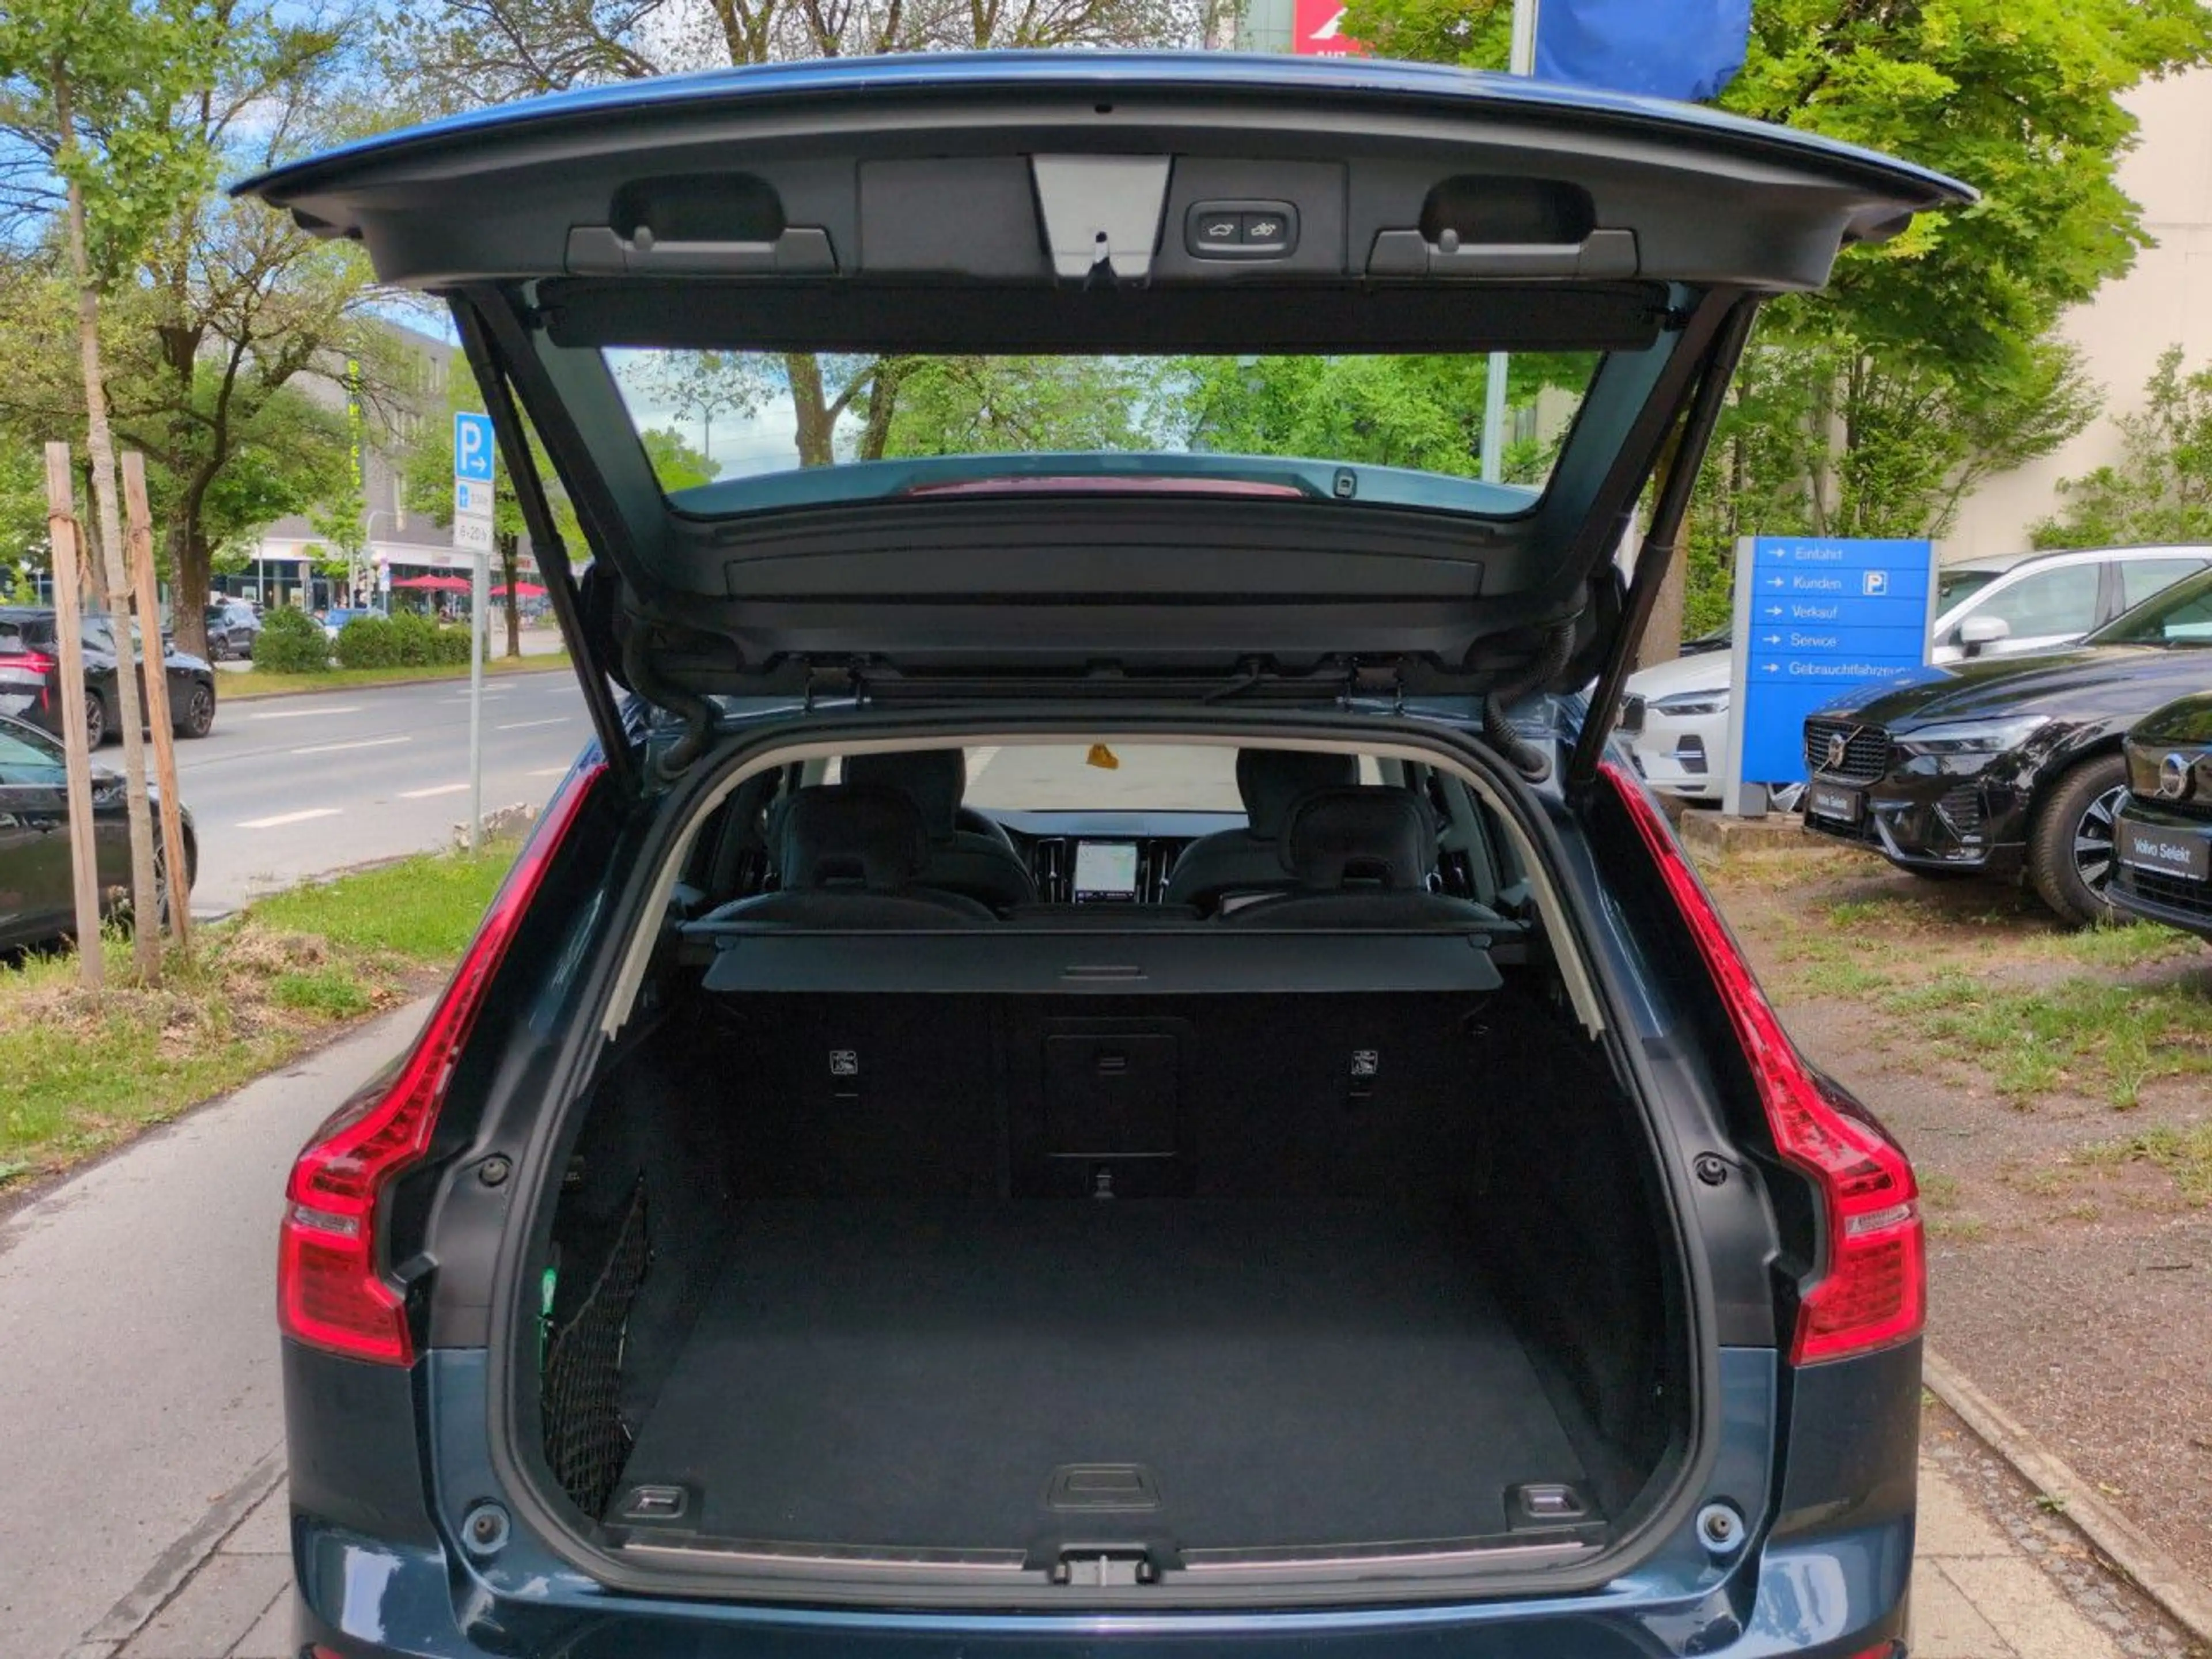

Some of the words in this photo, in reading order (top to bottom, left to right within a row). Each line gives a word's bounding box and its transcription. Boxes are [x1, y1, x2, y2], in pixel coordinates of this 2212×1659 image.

[460, 421, 482, 471] P
[1794, 547, 1843, 560] Einfahrt
[1793, 575, 1842, 589] Kunden
[1791, 605, 1838, 619] Verkauf
[1790, 632, 1837, 647] Service
[2134, 837, 2158, 857] Volvo
